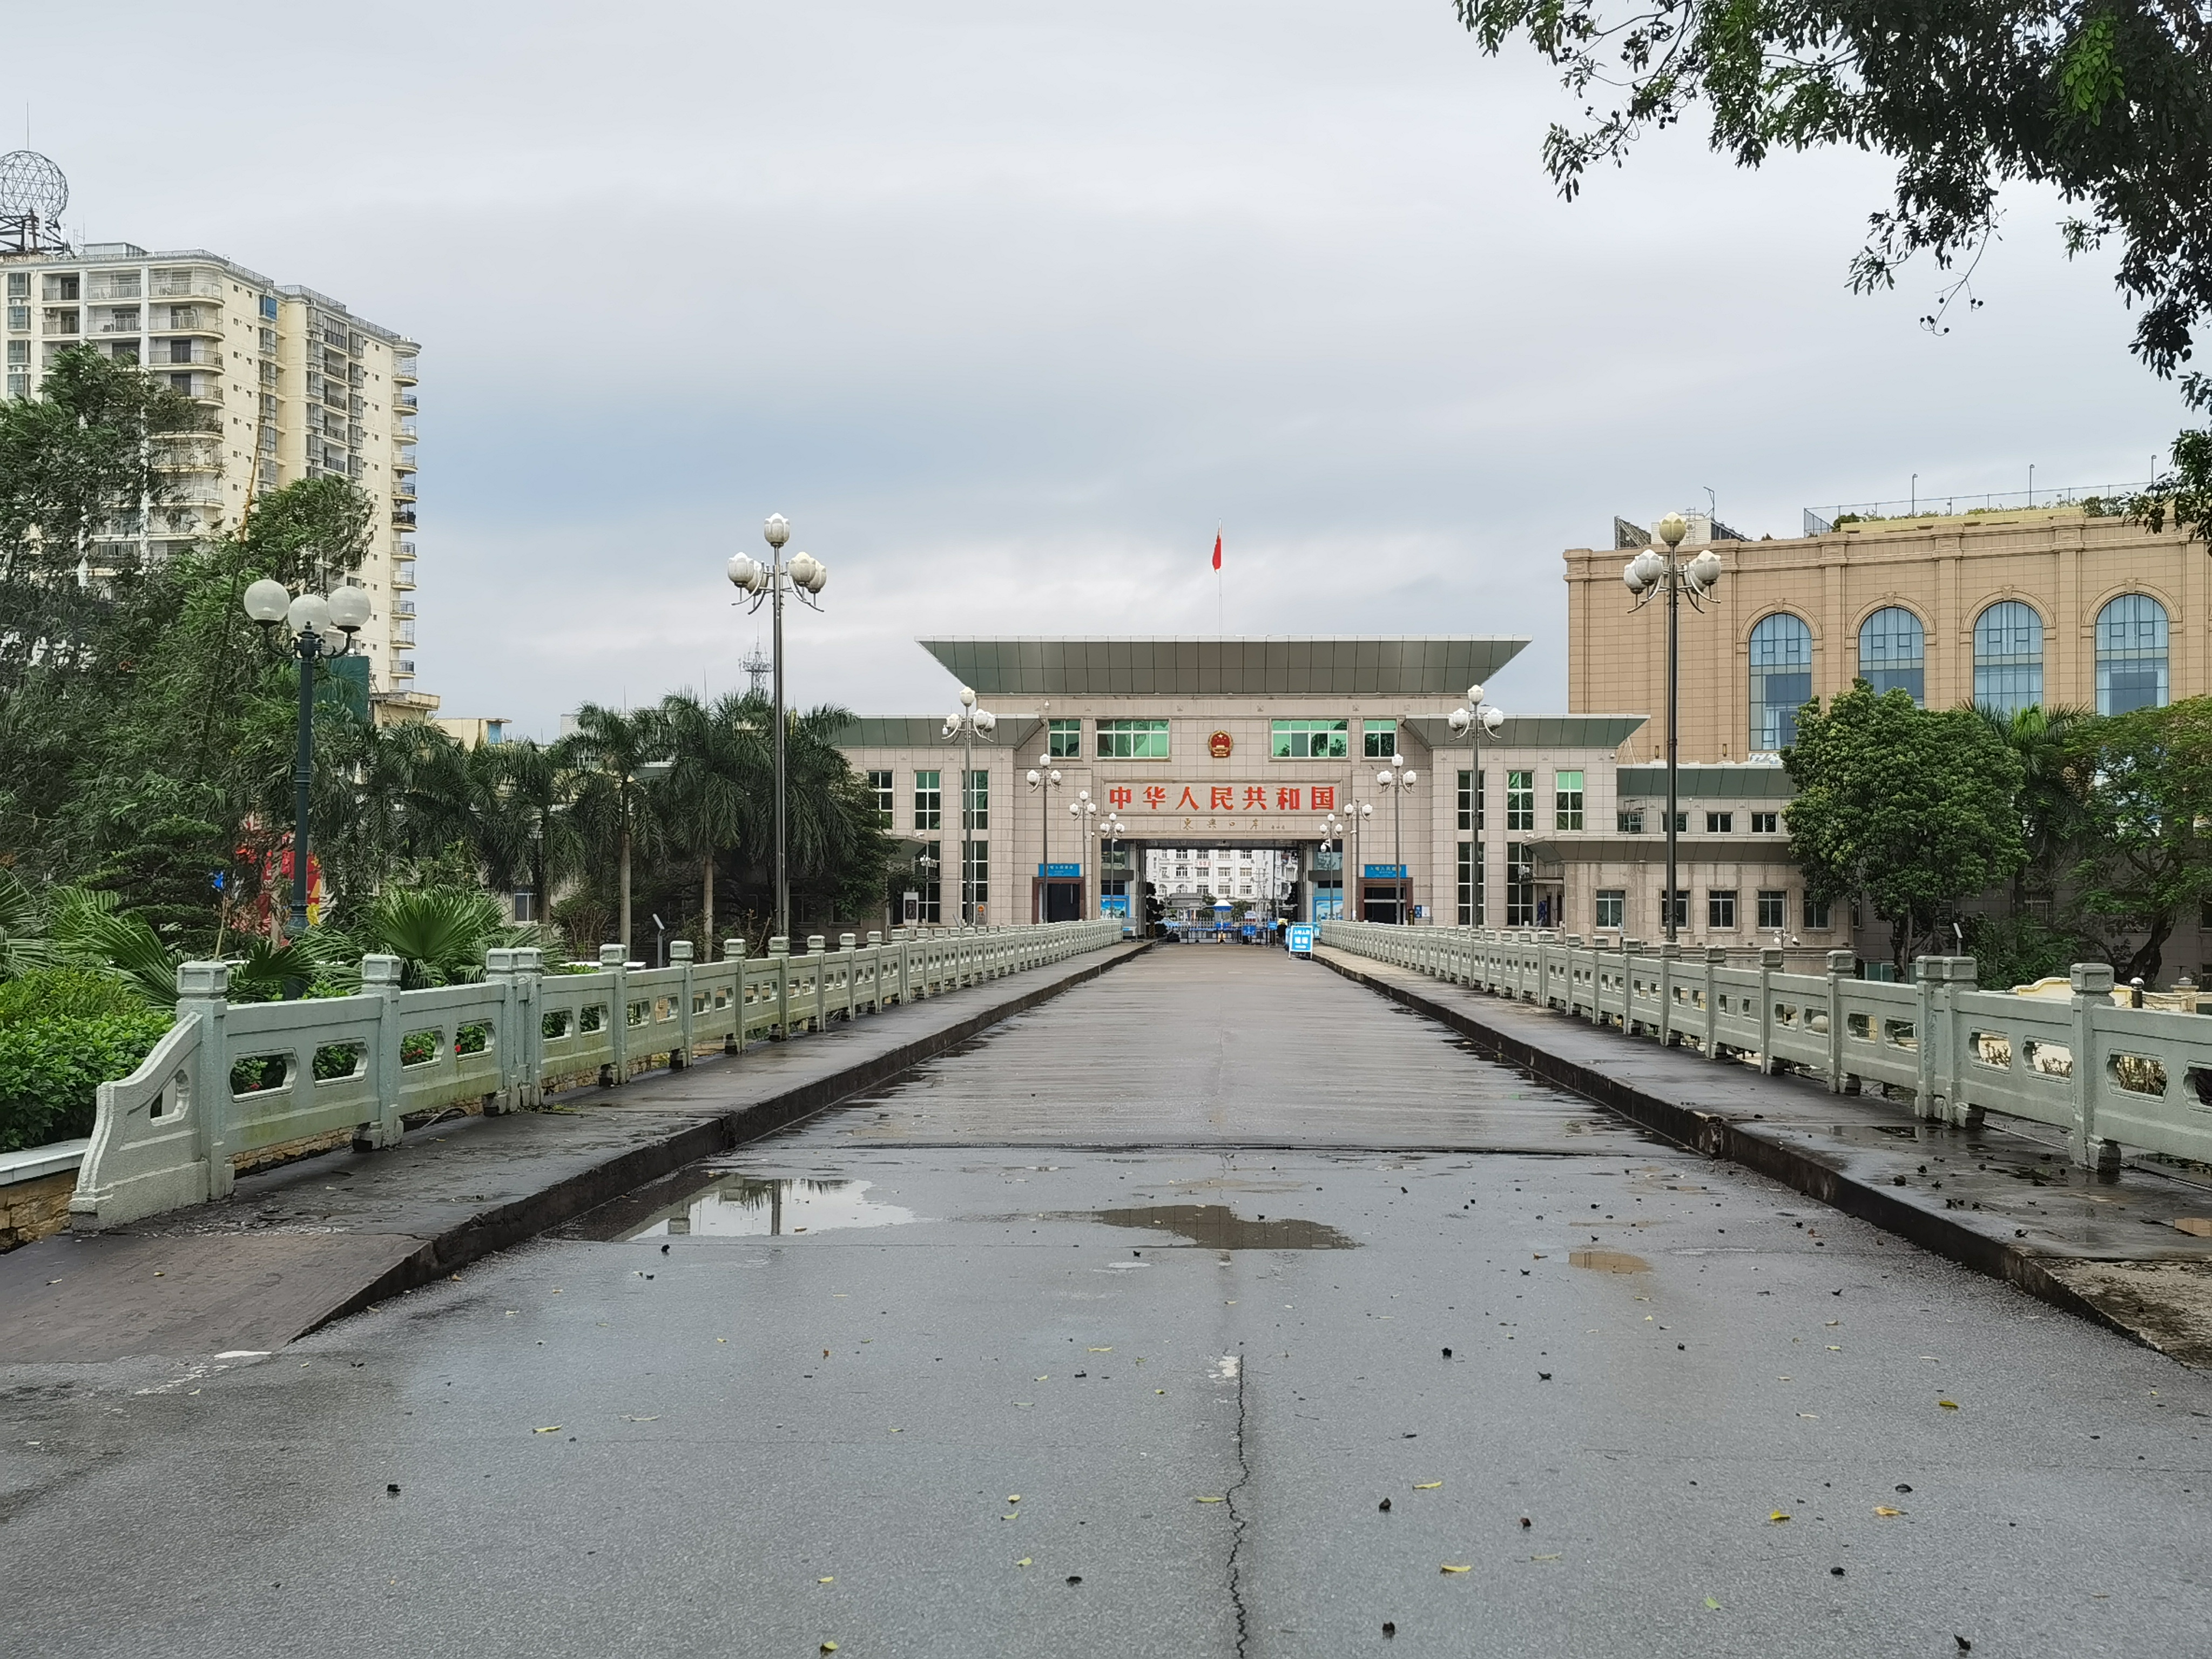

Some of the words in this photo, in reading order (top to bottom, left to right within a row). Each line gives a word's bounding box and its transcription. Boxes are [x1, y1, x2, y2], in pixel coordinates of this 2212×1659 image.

[1109, 786, 1334, 810] 中华人民共和国
